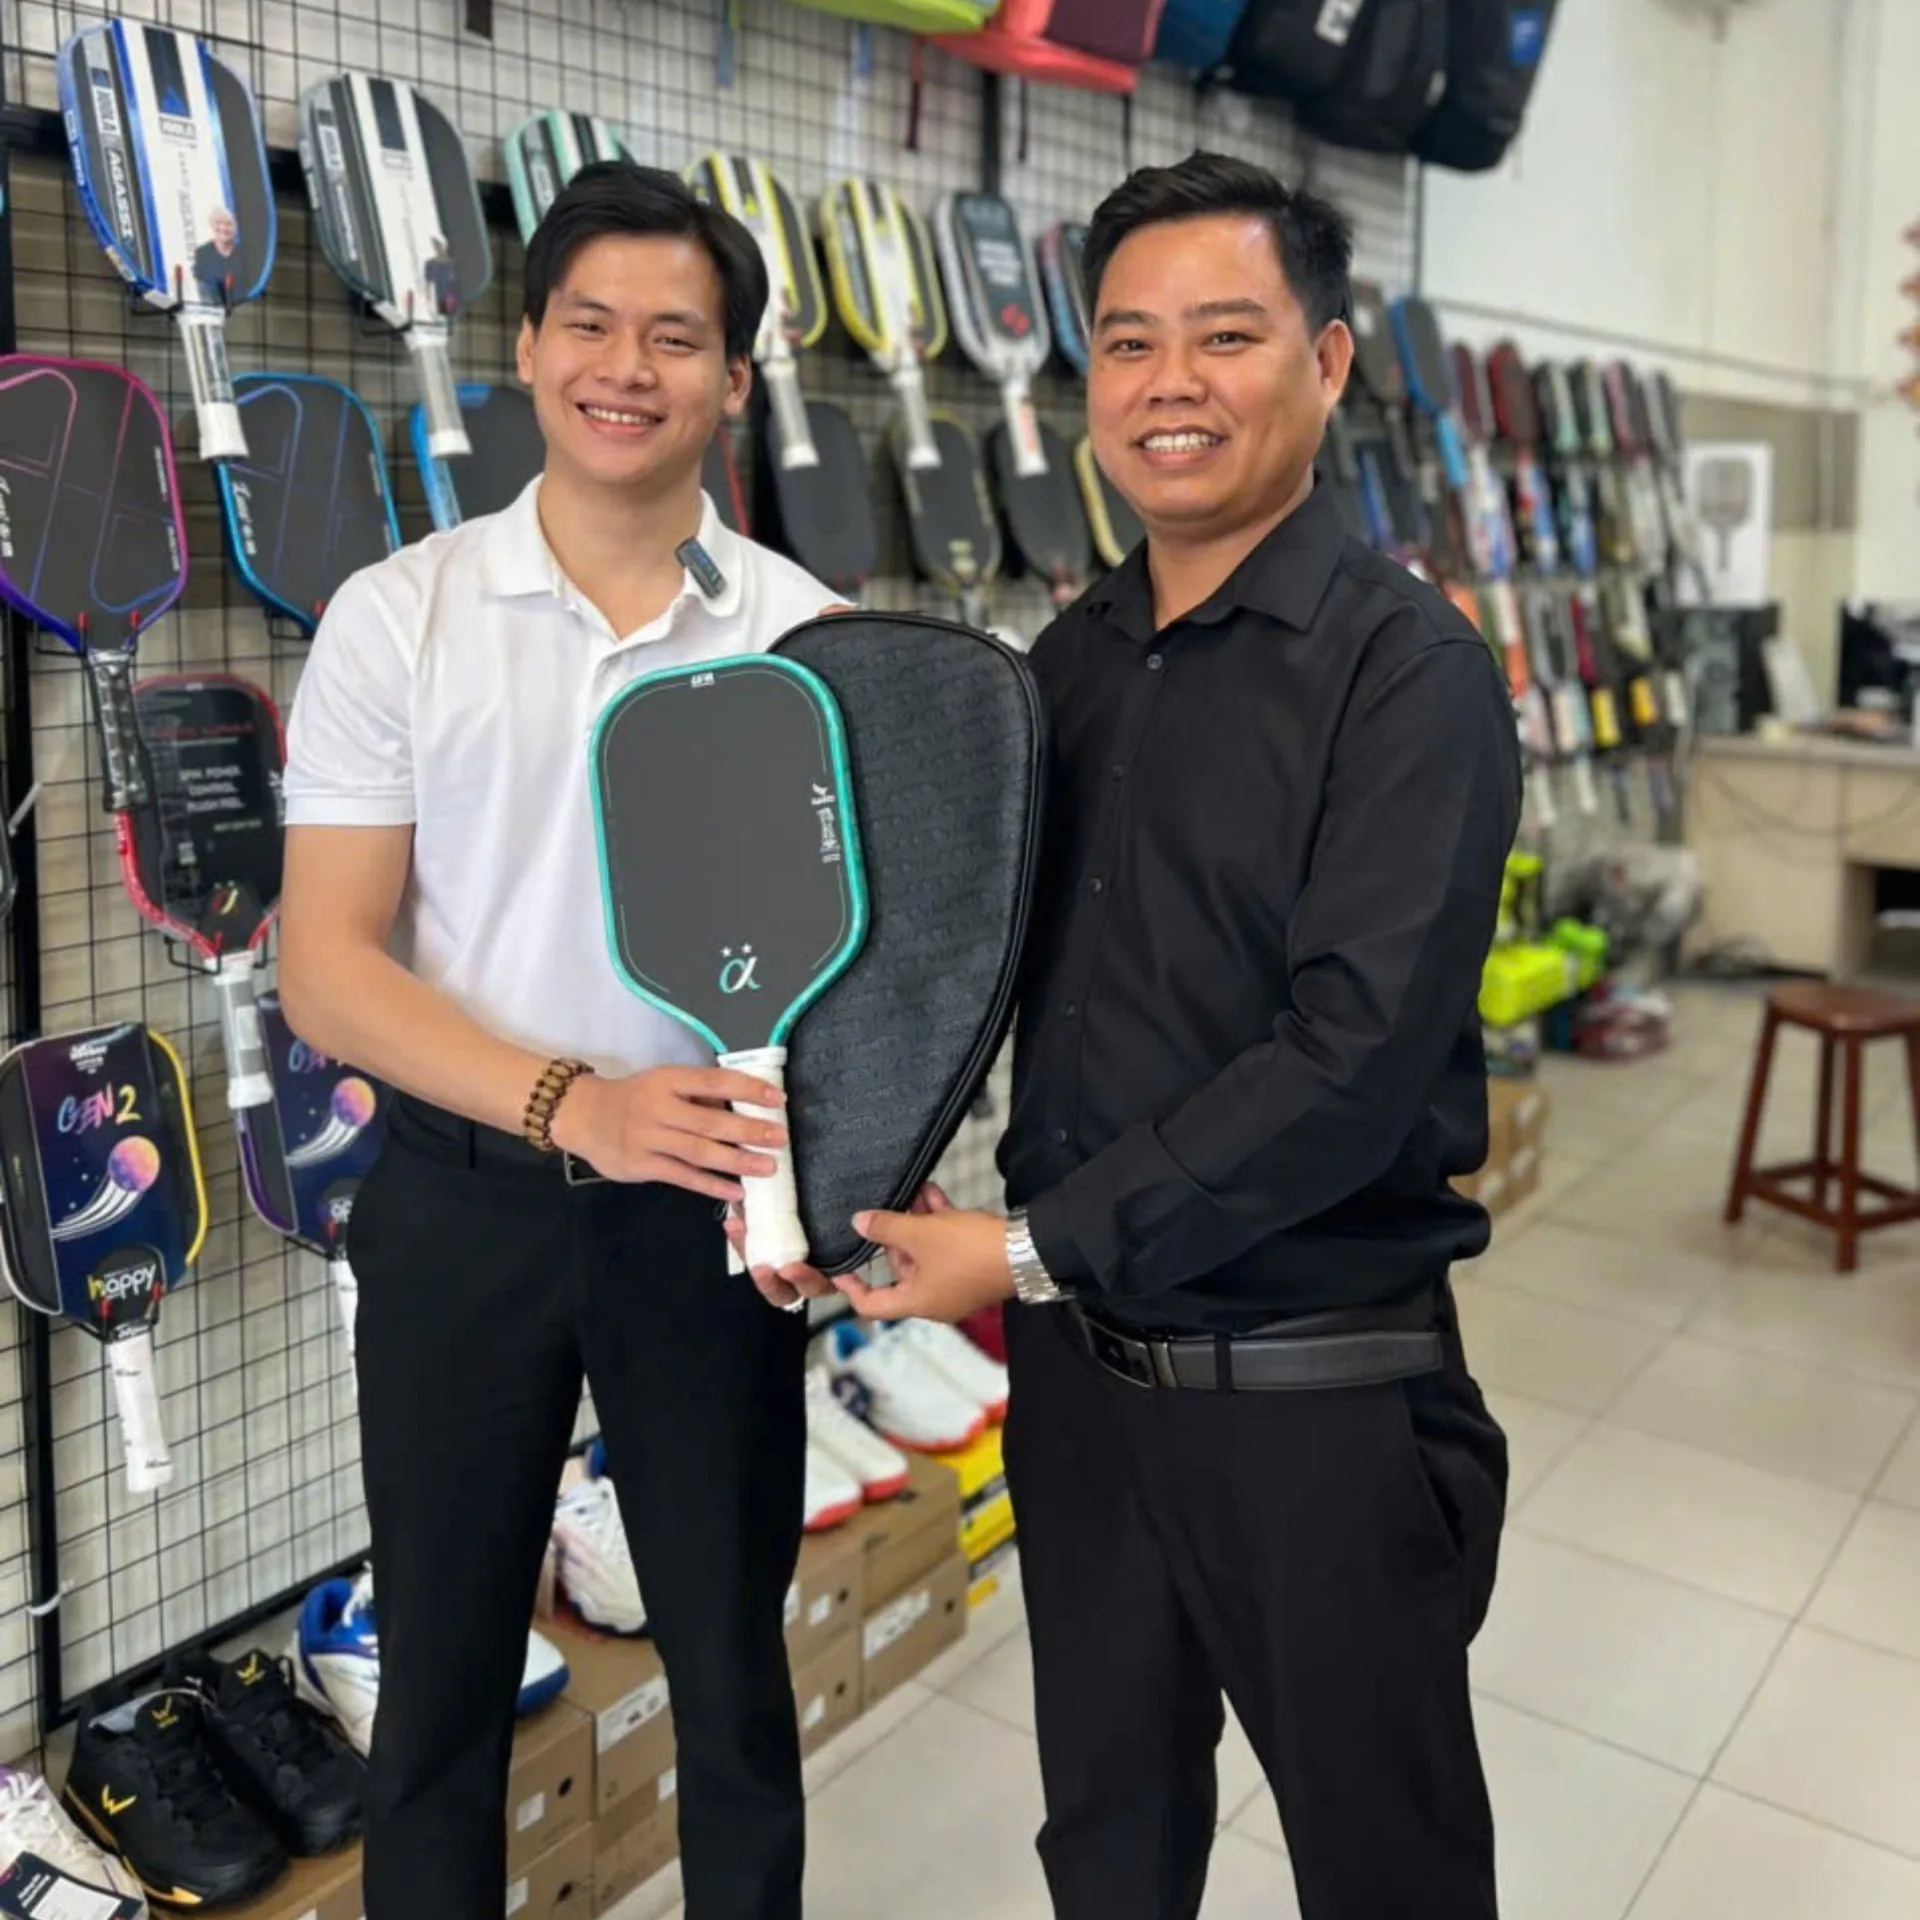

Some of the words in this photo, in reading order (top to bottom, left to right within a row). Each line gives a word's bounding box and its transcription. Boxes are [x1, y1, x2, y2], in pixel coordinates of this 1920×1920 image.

[108, 151, 134, 239] AGASSI
[57, 1082, 114, 1135] GEN
[115, 1084, 142, 1126] 2
[87, 1263, 157, 1301] happy
